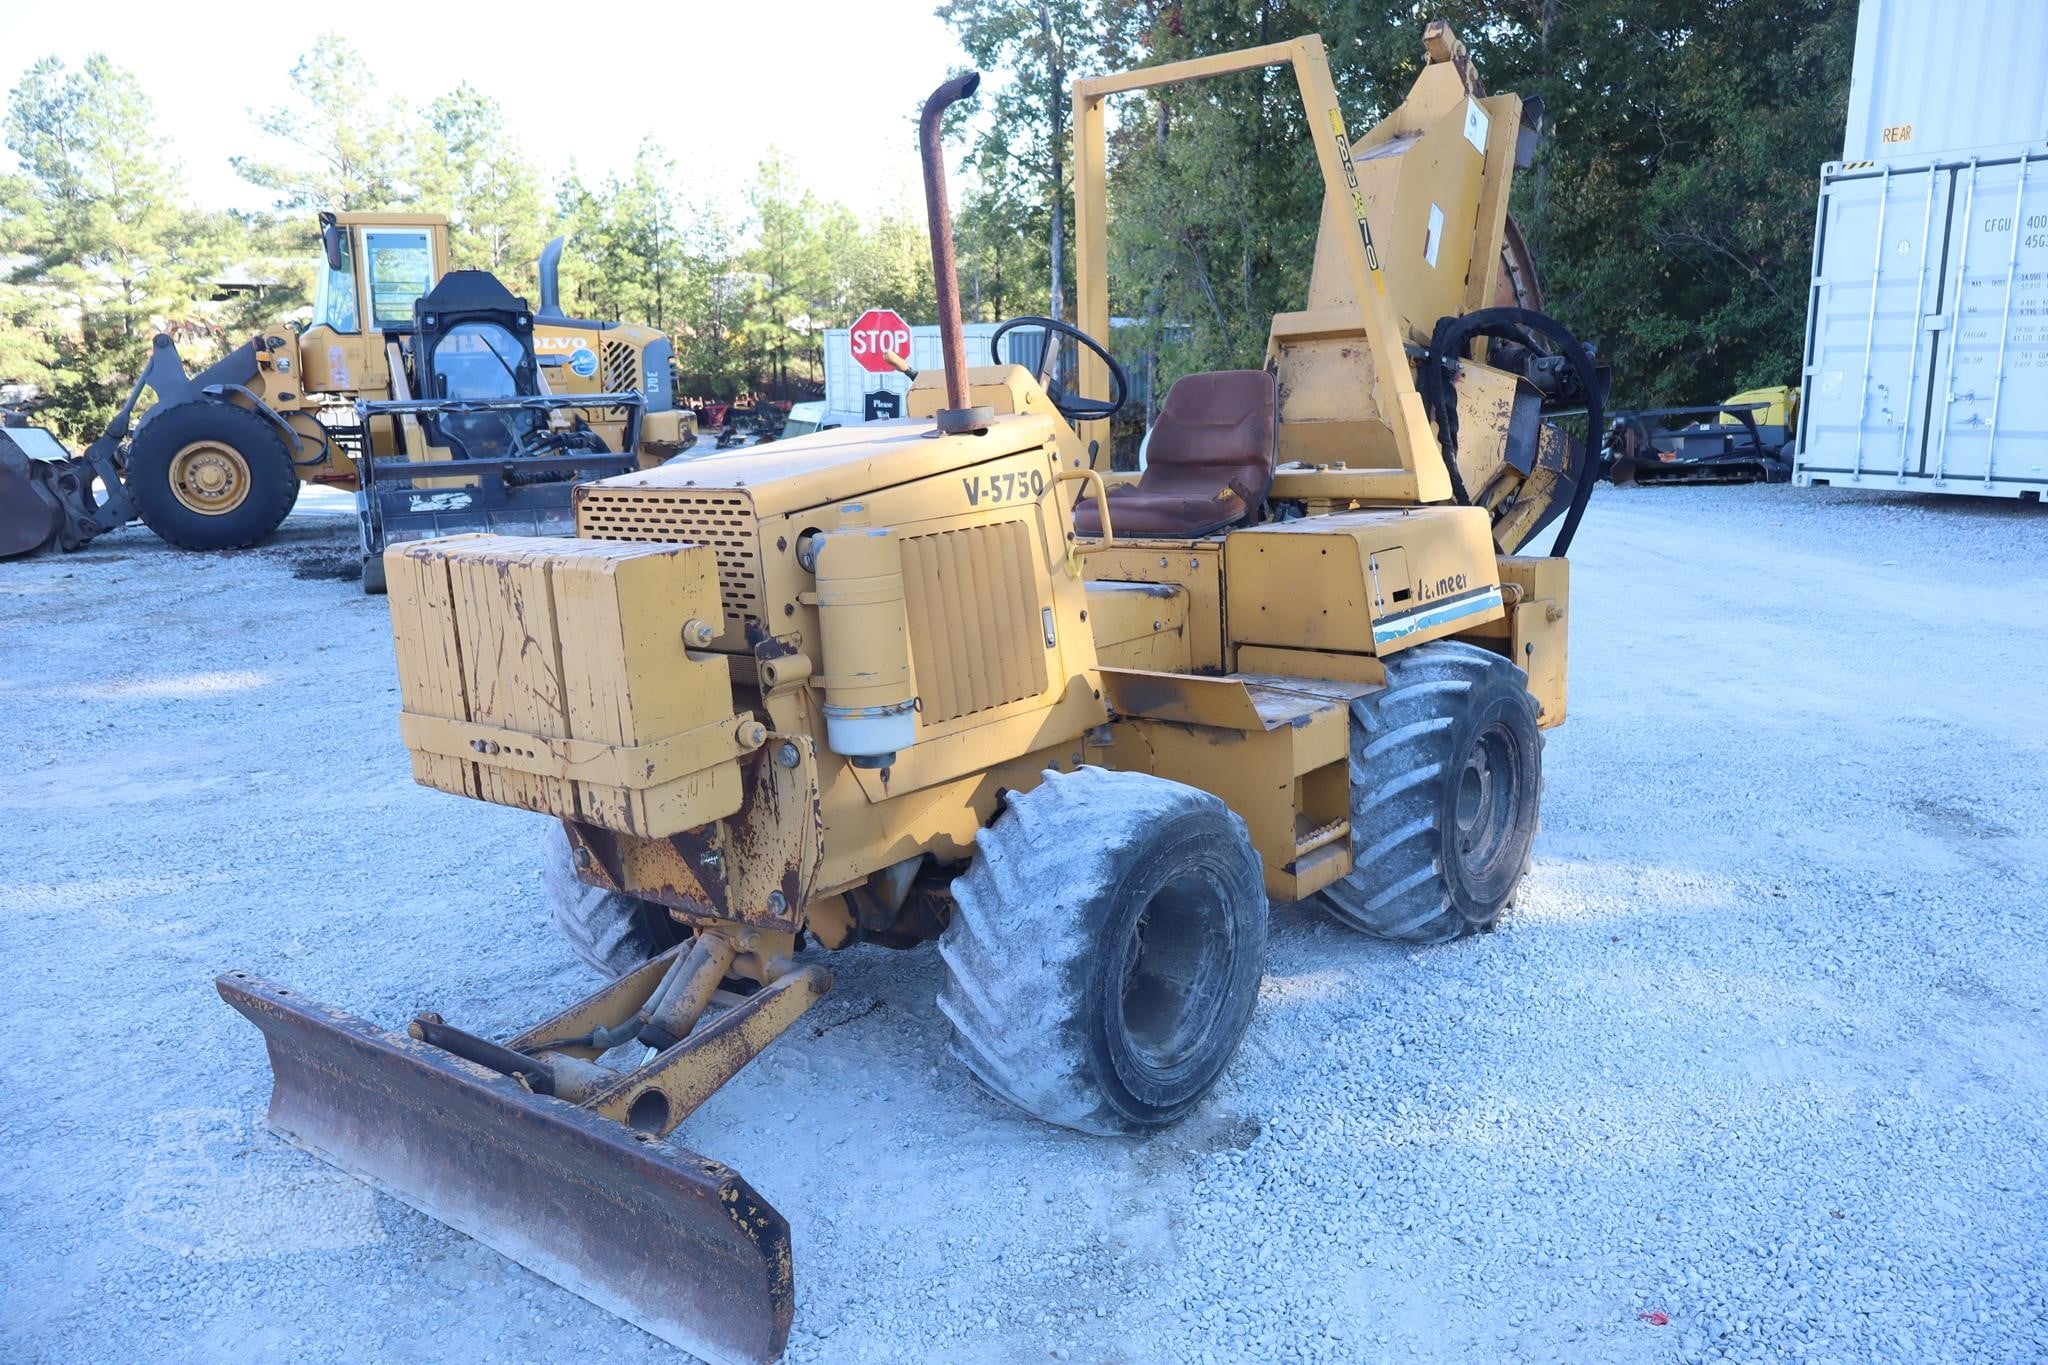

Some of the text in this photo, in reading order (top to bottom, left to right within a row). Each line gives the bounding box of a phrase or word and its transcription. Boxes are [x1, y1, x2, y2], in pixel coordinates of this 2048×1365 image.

[1882, 125, 1912, 143] REAR
[1984, 214, 2048, 232] CFGU 400
[533, 337, 587, 349] OLVO
[853, 330, 909, 354] STOP
[646, 371, 659, 393] L70E
[873, 400, 894, 408] Please
[962, 469, 1043, 506] V-5750
